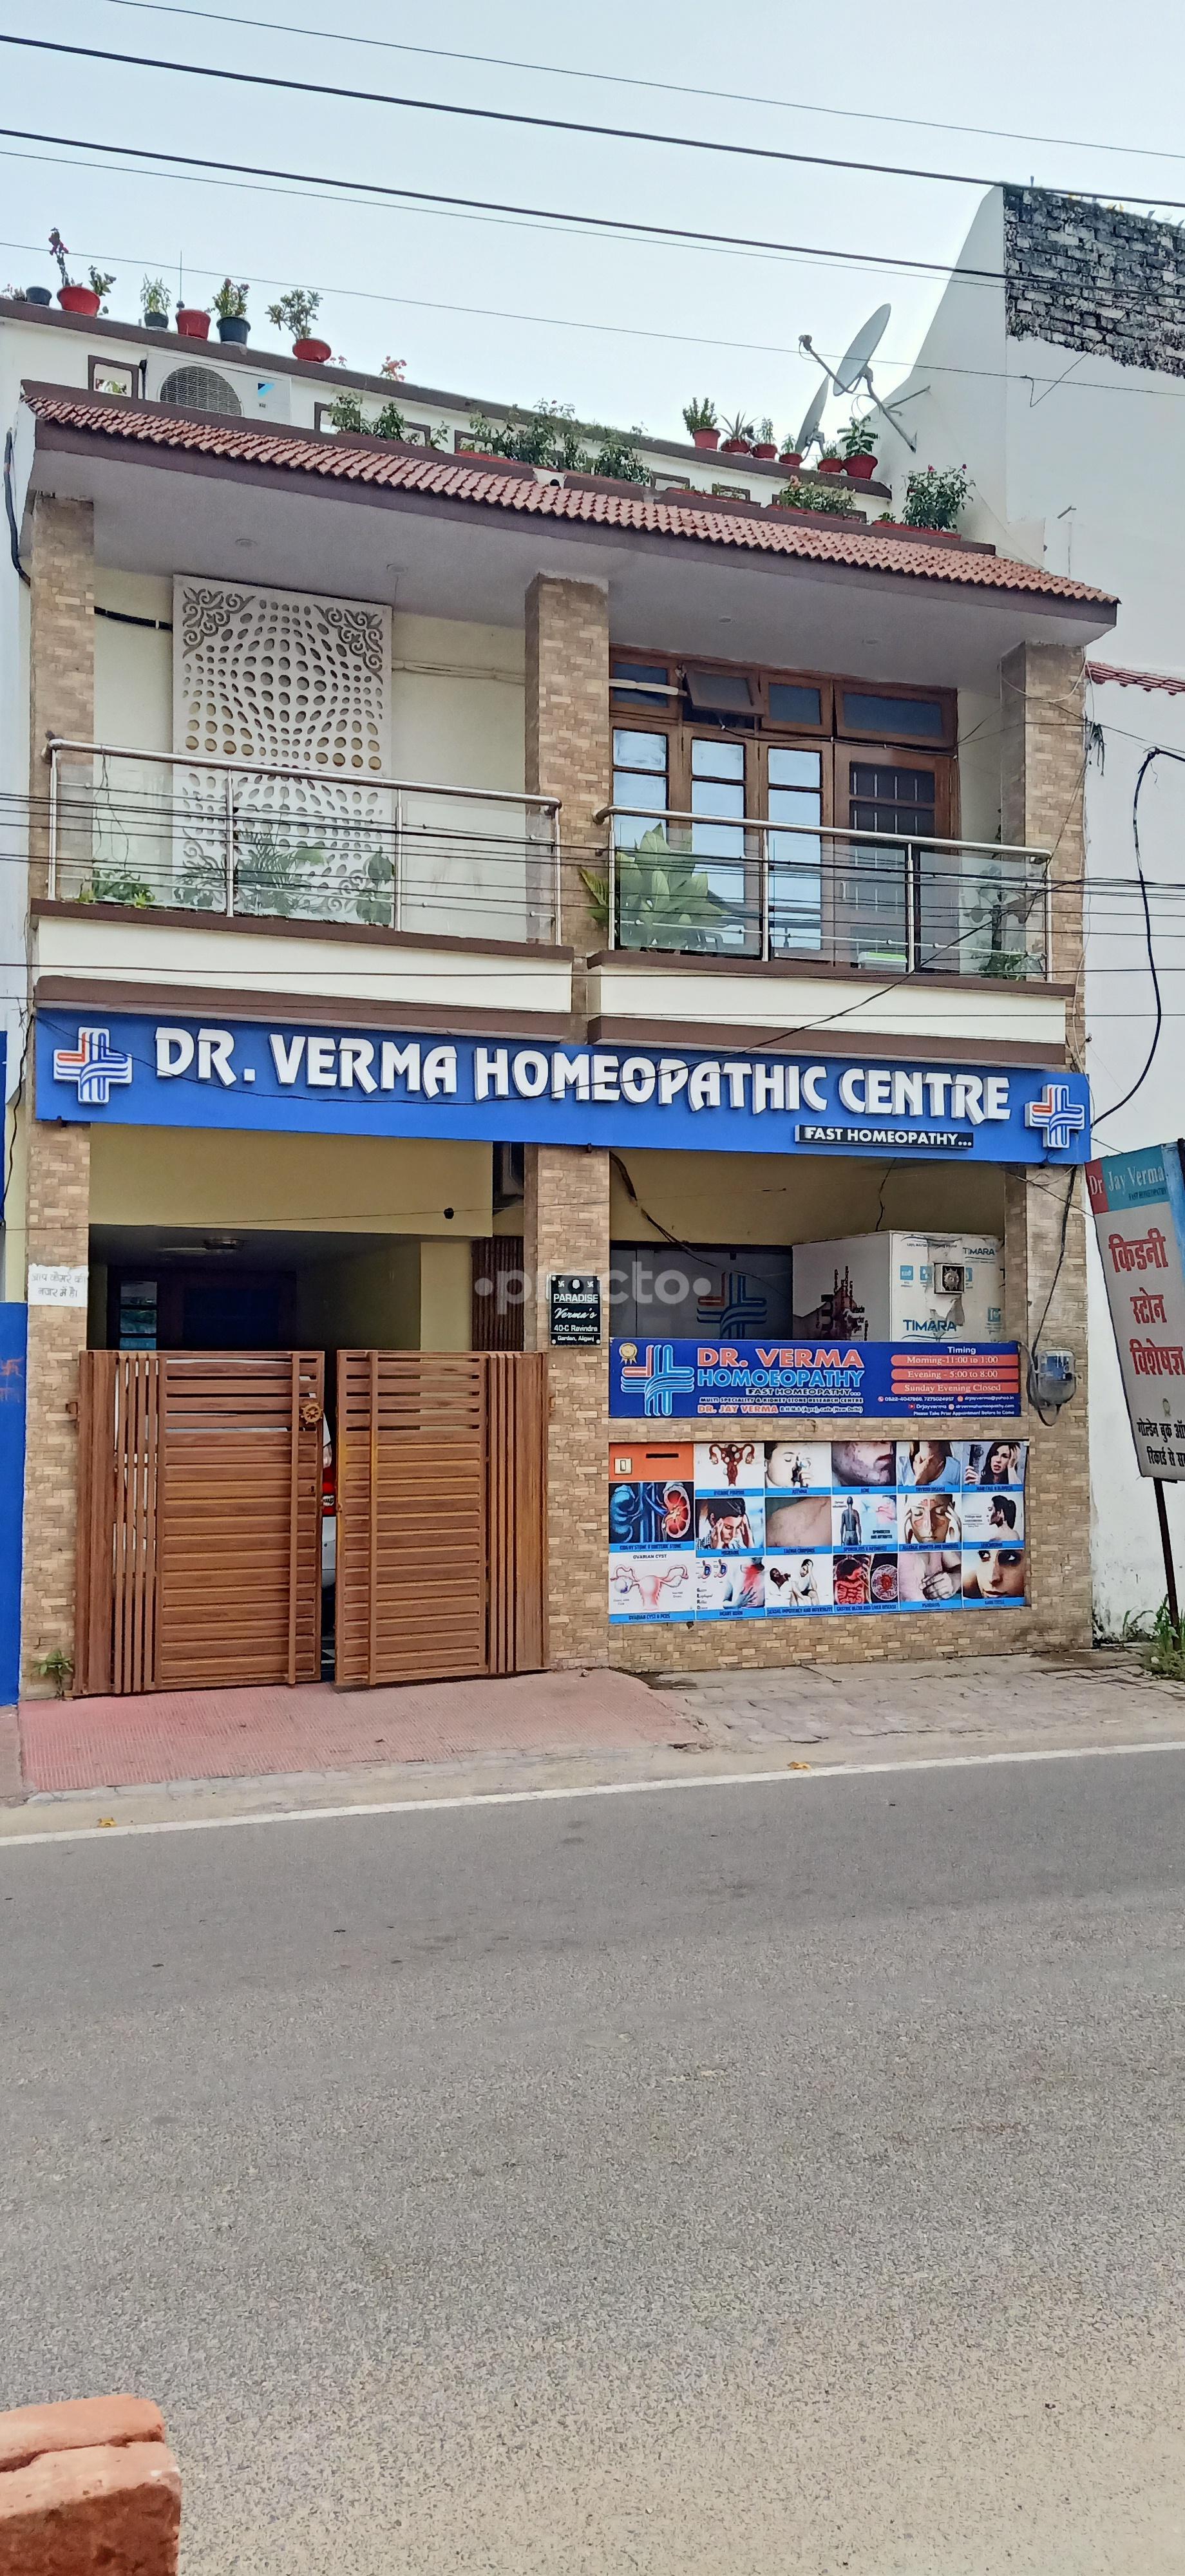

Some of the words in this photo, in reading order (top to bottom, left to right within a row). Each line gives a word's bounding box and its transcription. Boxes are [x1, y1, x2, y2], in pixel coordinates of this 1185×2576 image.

[156, 1027, 255, 1087] DR.
[269, 1033, 457, 1100] VERMA
[474, 1046, 828, 1115] HOMEOPATHIC
[839, 1068, 1011, 1126] CENTRE
[805, 1126, 843, 1141] FAST
[847, 1131, 972, 1146] HOMEOPATHY...
[1088, 1175, 1103, 1196] Dr
[1108, 1171, 1126, 1195] Jay
[1127, 1166, 1165, 1186] Verma
[962, 1247, 996, 1256] TIMARA
[1108, 1227, 1169, 1273] किडनी
[553, 1293, 598, 1302] PARADISE
[1130, 1287, 1168, 1324] स्टोन
[554, 1307, 598, 1320] Verma's
[903, 1318, 958, 1332] TIMARA
[697, 1348, 748, 1367] DR.
[755, 1348, 865, 1368] VERMA
[947, 1346, 976, 1355] Timing
[697, 1369, 865, 1387] HOMOEOPATHY
[907, 1370, 942, 1379] Evening
[904, 1384, 934, 1394] Sunday
[937, 1385, 971, 1394] Evening
[697, 1405, 716, 1414] DR.
[719, 1405, 739, 1414] JAY
[741, 1405, 779, 1414] VERMA
[1174, 1419, 1185, 1439] ऑ
